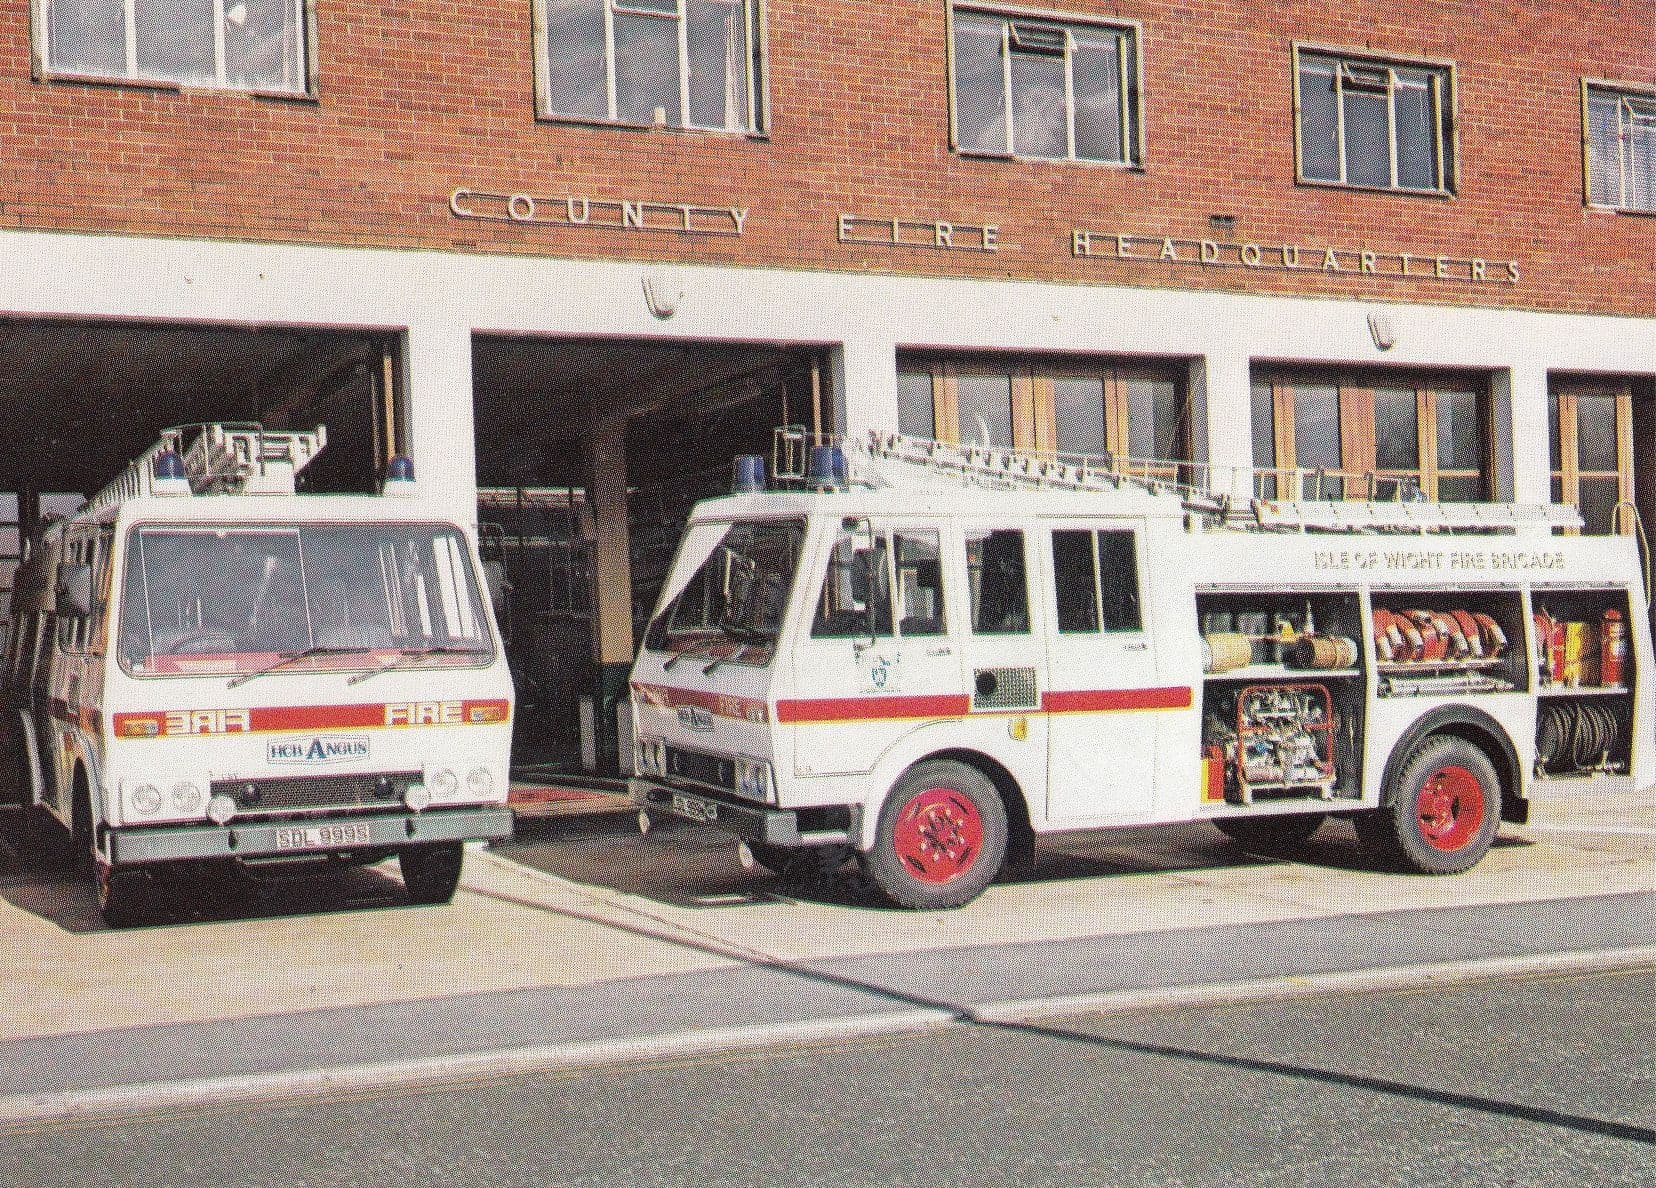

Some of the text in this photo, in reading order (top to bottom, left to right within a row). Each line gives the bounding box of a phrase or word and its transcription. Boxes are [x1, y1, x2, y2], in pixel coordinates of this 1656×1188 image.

[450, 188, 1520, 286] COUNTY FIRE HEADQUARTERS
[1314, 551, 1565, 569] ISLE OF WIGHT FIRE BRIGADE
[384, 701, 463, 727] FIRE
[305, 737, 368, 760] ANGUS
[278, 828, 315, 848] SDL
